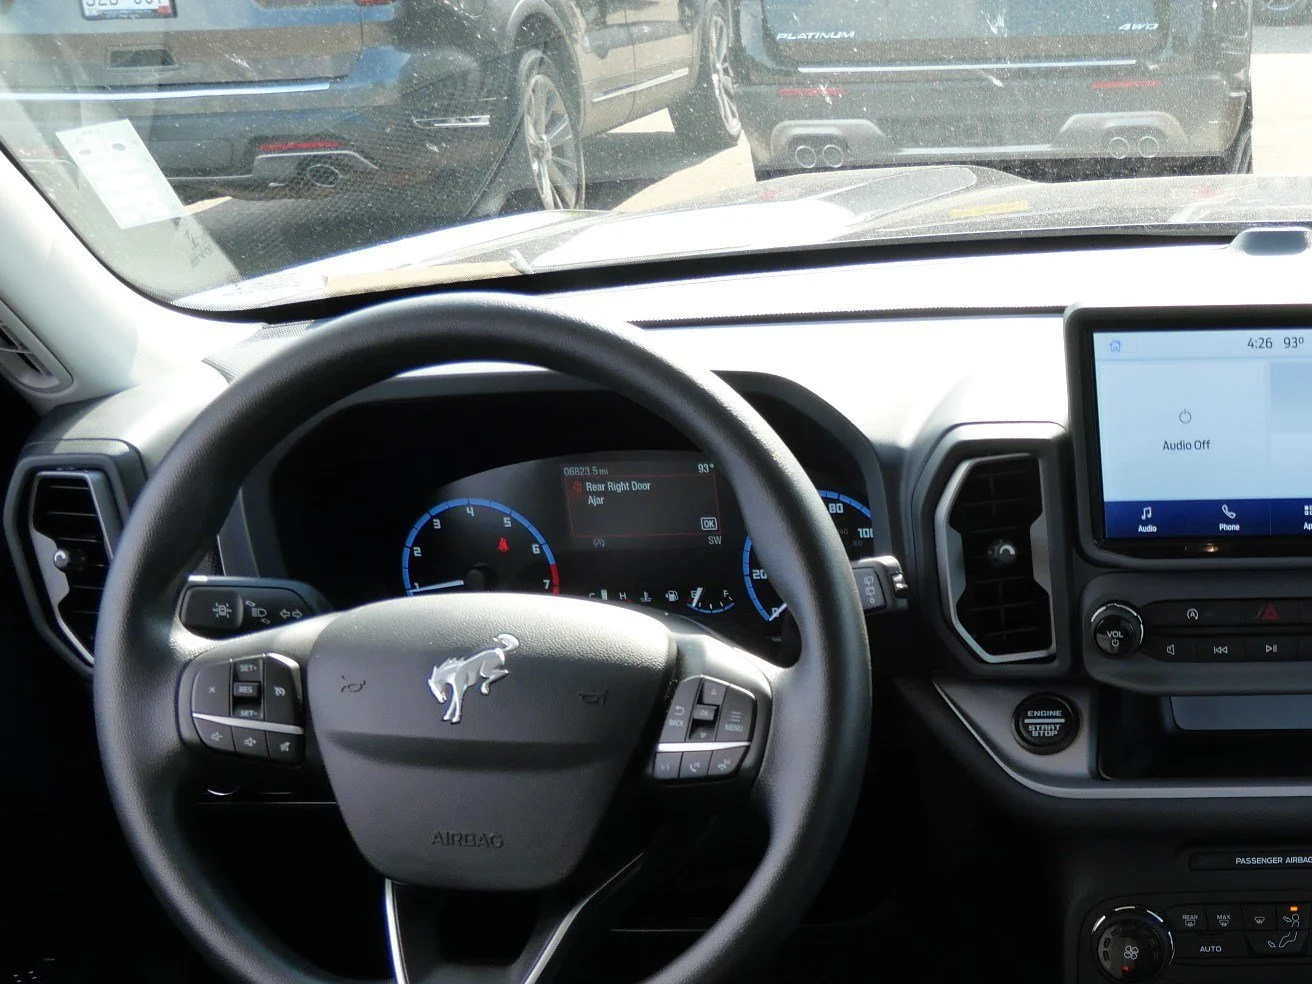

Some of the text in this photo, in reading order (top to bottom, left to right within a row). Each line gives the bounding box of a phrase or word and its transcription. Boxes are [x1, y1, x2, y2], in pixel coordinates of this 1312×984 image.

[776, 31, 856, 40] PLATINUM
[1247, 336, 1273, 349] 4:26
[1162, 440, 1211, 450] Audio Off
[586, 480, 651, 493] Rear Right Door
[588, 495, 604, 506] Ajar
[466, 506, 475, 517] 4
[828, 503, 844, 514] 80
[433, 519, 442, 529] 3
[503, 517, 512, 528] 5
[703, 519, 715, 528] OK
[1219, 523, 1240, 531] Phone
[708, 536, 722, 545] SW
[413, 547, 422, 557] 2
[532, 544, 540, 554] 6
[752, 569, 768, 580] 20
[543, 580, 551, 590] 7
[619, 592, 627, 600] H
[1106, 630, 1124, 638] VOL
[725, 724, 744, 732] MENU
[431, 831, 504, 848] AIRBAG
[1235, 856, 1283, 865] PASSENGER
[1200, 945, 1222, 953] AUTO
